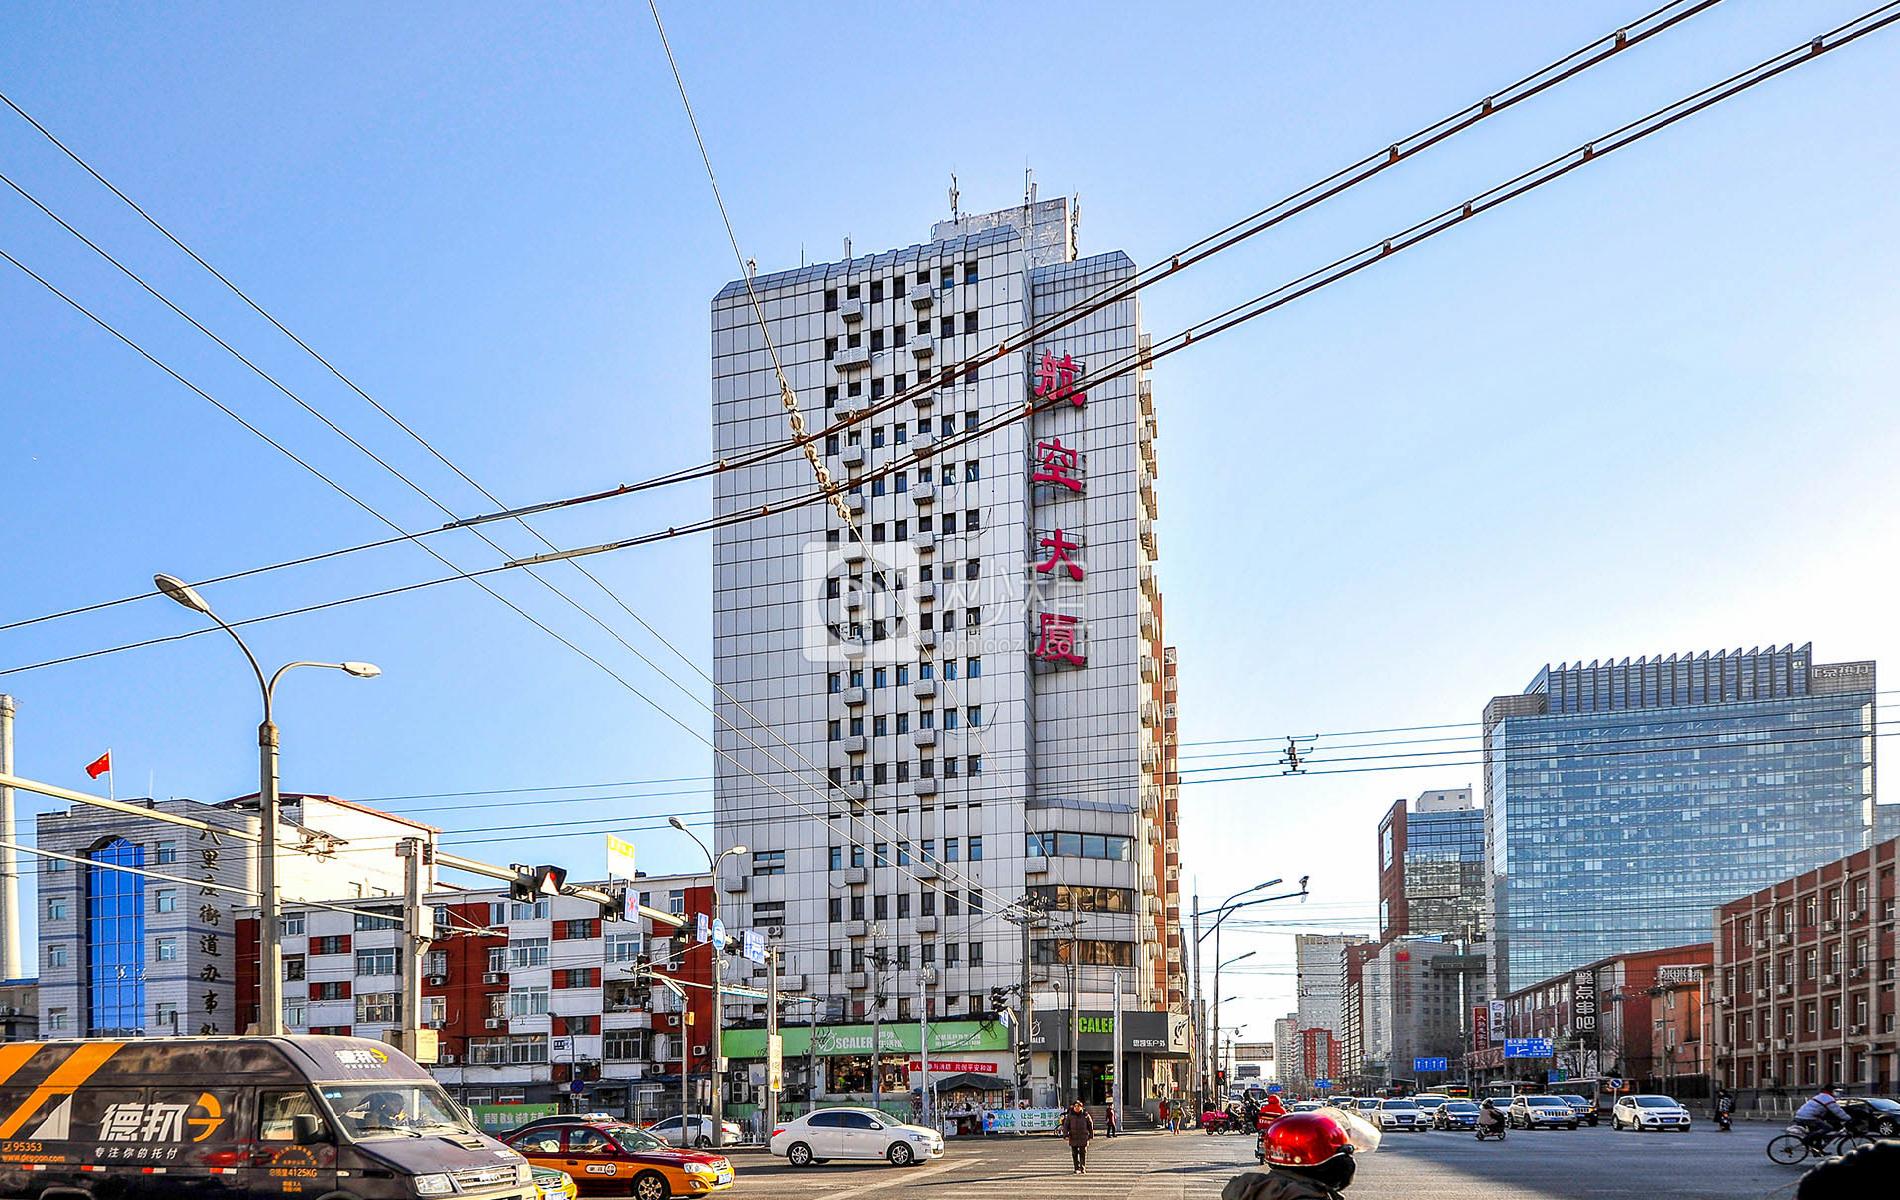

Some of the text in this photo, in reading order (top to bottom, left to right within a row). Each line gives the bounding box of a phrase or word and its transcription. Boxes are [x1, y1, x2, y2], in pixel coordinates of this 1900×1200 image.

[1033, 348, 1088, 667] 航空大厦
[199, 828, 222, 1035] 八里庄街道办事处
[1070, 1017, 1114, 1033] CALE
[836, 1036, 873, 1048] SCALER
[98, 1102, 190, 1142] 德邦
[14, 1142, 42, 1152] 95353
[95, 1147, 178, 1159] 专注你的托付
